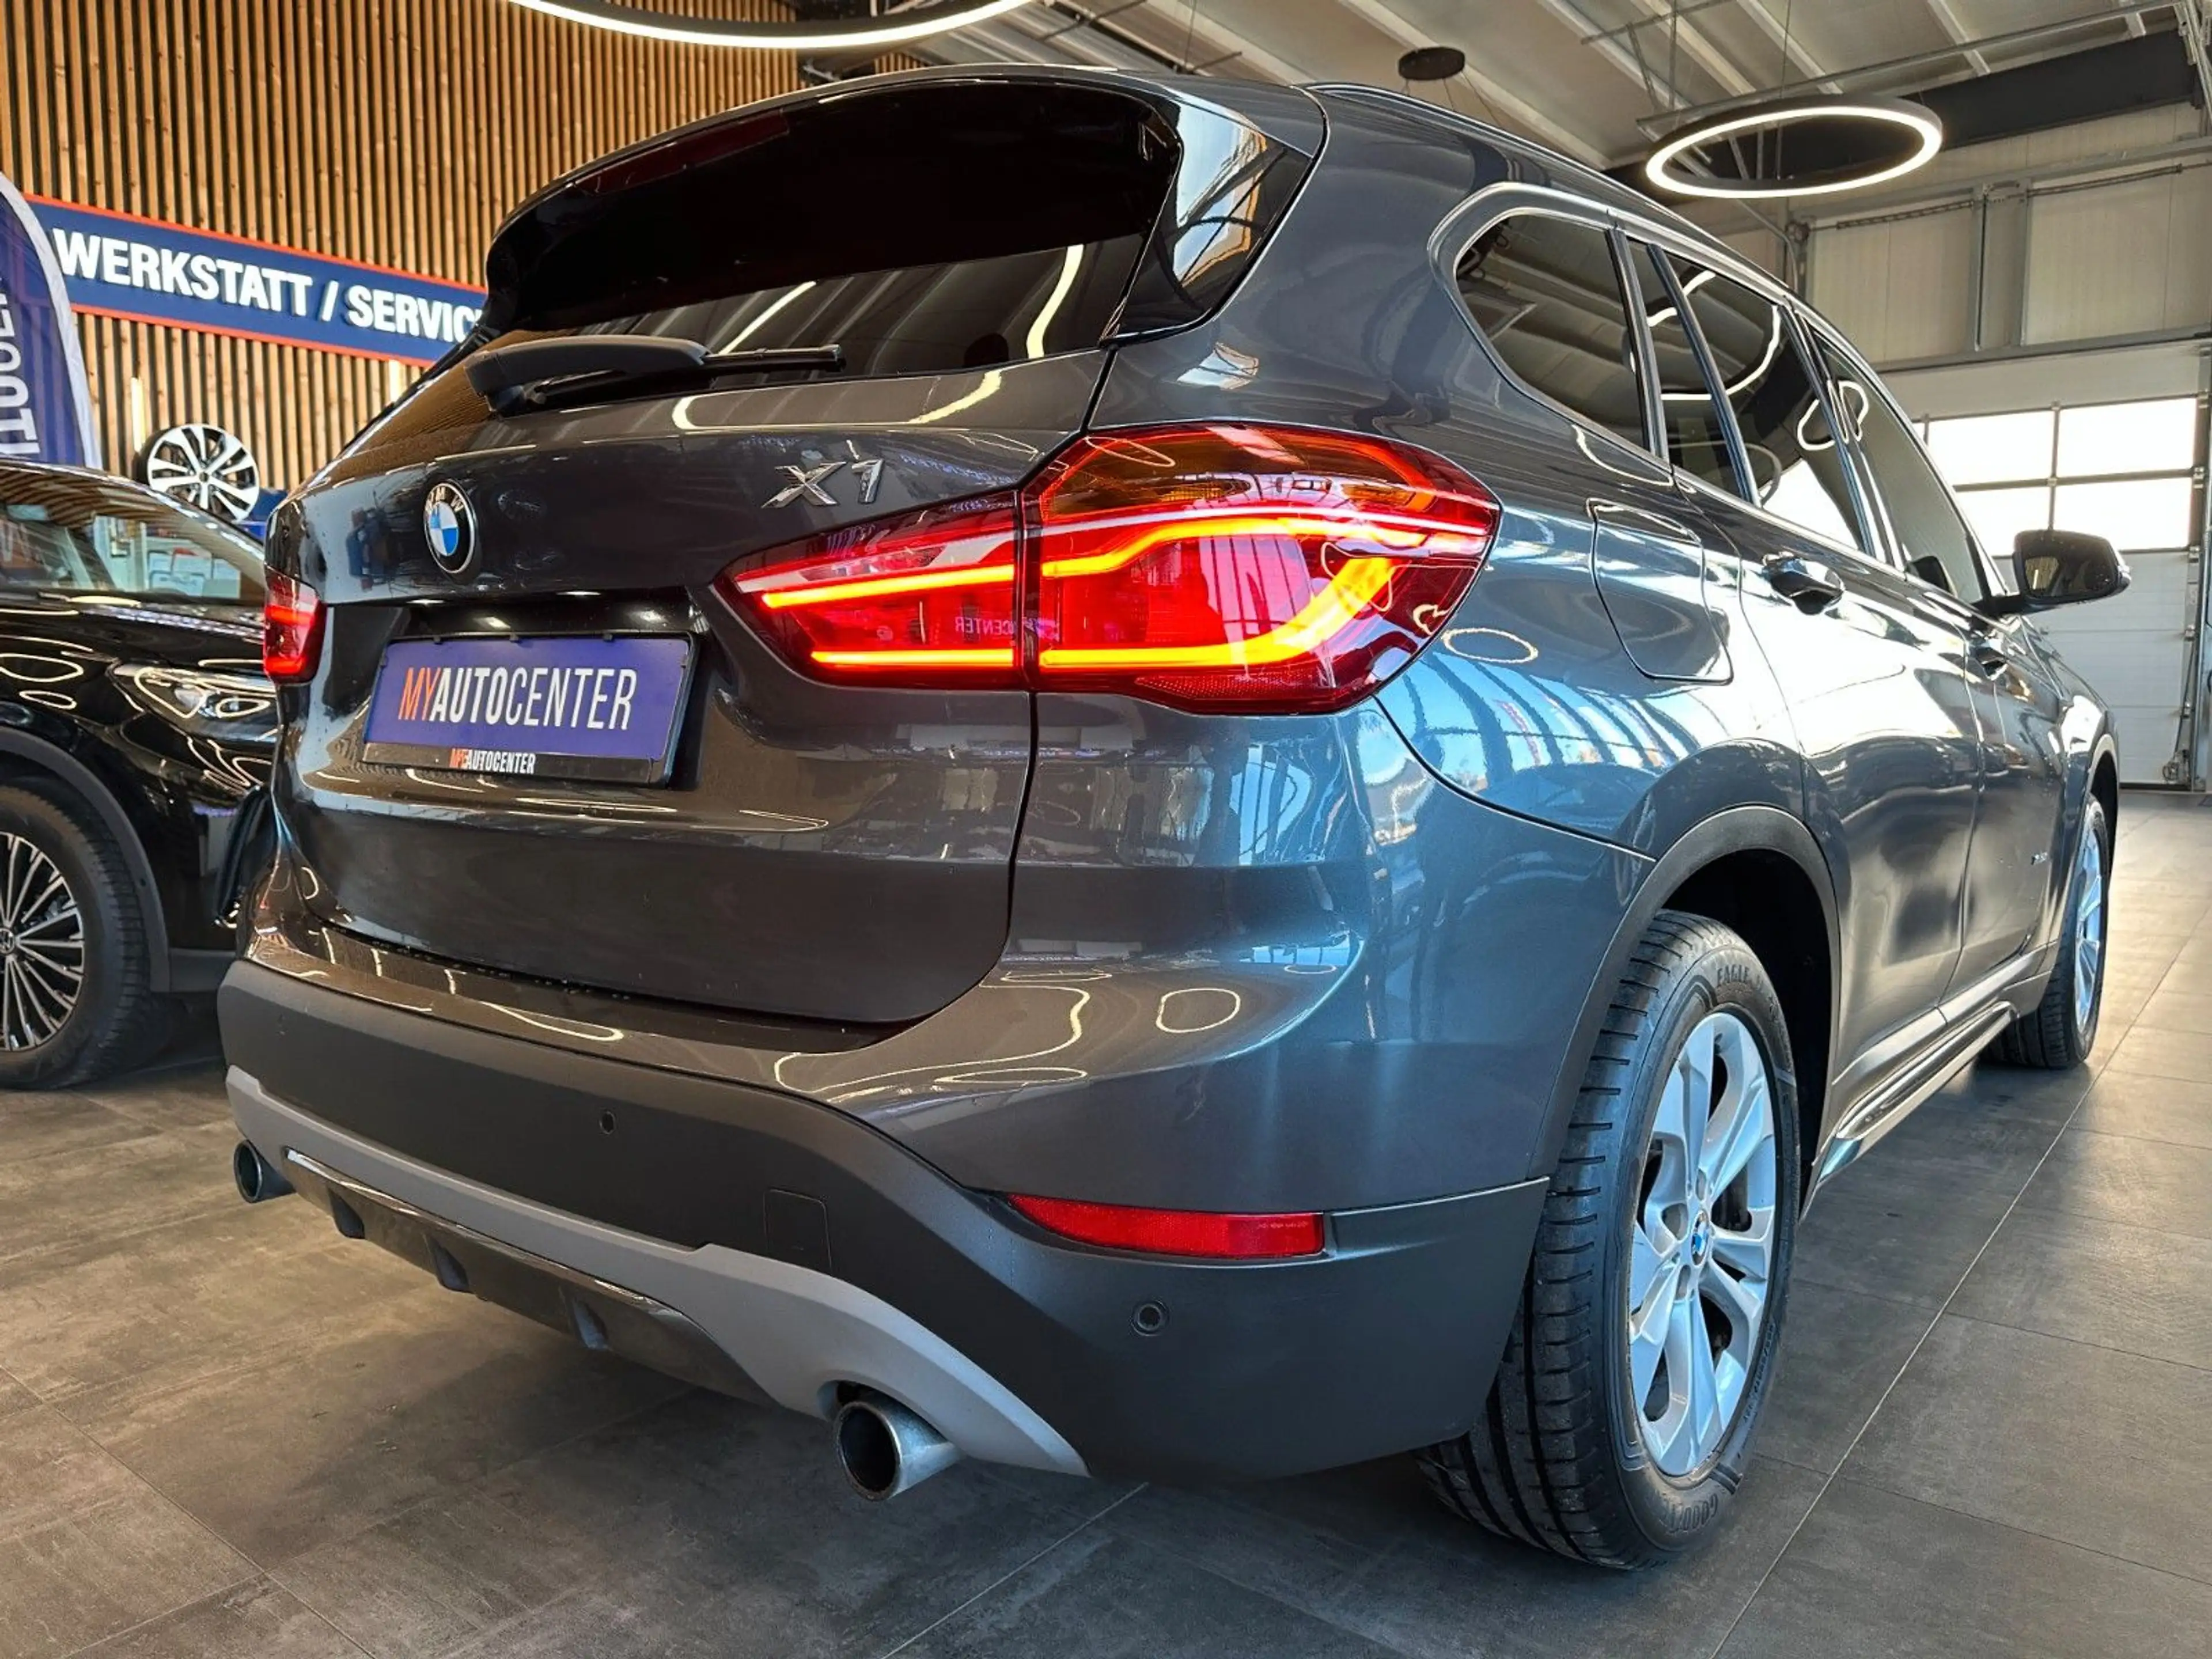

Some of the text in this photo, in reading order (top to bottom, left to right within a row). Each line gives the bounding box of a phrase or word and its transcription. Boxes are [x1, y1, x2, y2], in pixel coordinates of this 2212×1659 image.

[53, 228, 482, 343] WERKSTATT / SERVIC
[761, 459, 883, 508] X1
[398, 666, 637, 730] MYAUTOCENTER
[1715, 963, 1750, 988] EAGLE
